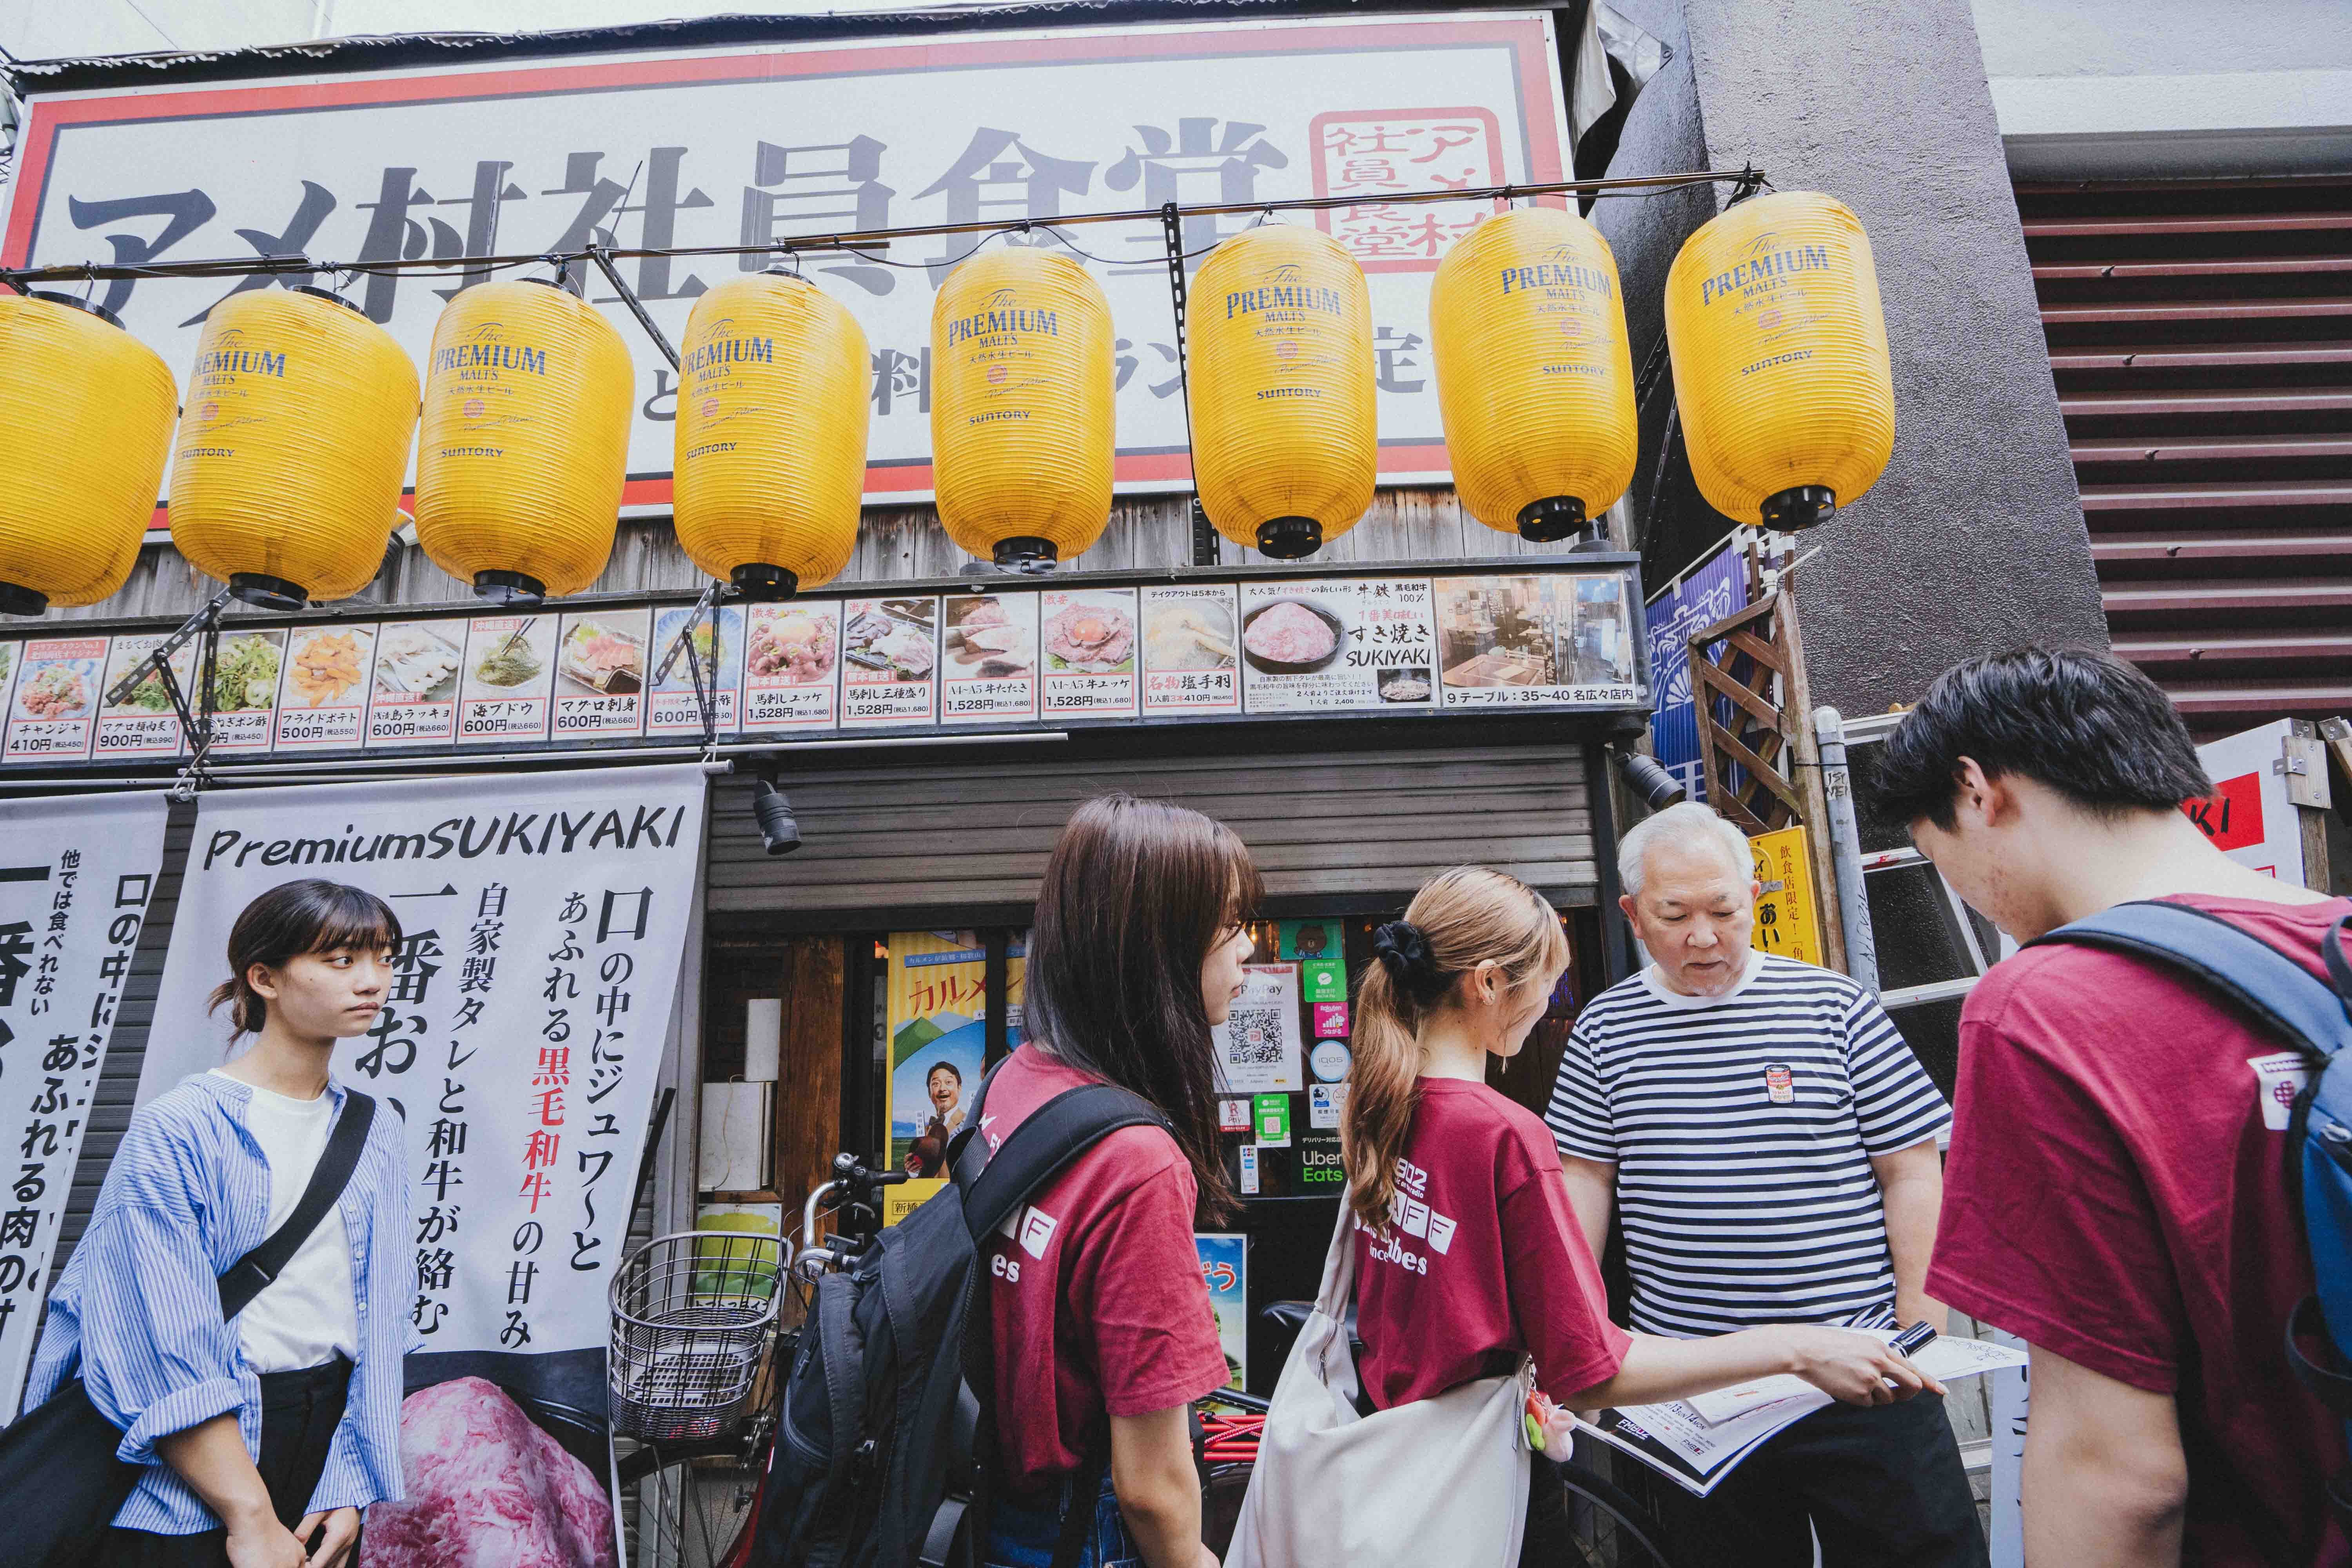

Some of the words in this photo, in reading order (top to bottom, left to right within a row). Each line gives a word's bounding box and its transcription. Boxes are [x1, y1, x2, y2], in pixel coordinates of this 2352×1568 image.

[1501, 264, 1613, 301] PREMIUM
[1701, 245, 1830, 307] PREMIUM
[1227, 286, 1341, 320] PREMIUM
[949, 309, 1058, 348] PREMIUM
[435, 344, 546, 376] PREMIUM
[681, 336, 773, 382] PREMIUM
[1741, 350, 1813, 376] SUNTORY
[1543, 364, 1606, 376] SUNTORY
[1257, 388, 1321, 400] SUNTORY
[969, 410, 1031, 426] SUNTORY
[182, 448, 235, 459] SUNTORY
[442, 447, 504, 458] SUNTORY
[686, 442, 738, 461] SUNTORY
[1044, 594, 1068, 606] 激安
[1151, 589, 1226, 598] テイクアウトは5本から
[1399, 593, 1425, 603] 100%
[1348, 623, 1430, 644] すき焼き
[1346, 647, 1430, 667] SUKIYAKI
[681, 694, 731, 707] ナ酢
[755, 693, 822, 705] 馬刺しユッケ
[848, 687, 926, 701] 馬刺し三種盛り
[561, 697, 637, 711] マグロ刺身
[947, 699, 994, 711] 1,528円
[1046, 695, 1093, 707] 1,528円
[473, 703, 534, 718] 海ブドウ
[654, 710, 697, 723] 600円
[748, 708, 793, 720] 1,528円
[846, 704, 892, 716] 1,528円
[282, 712, 358, 724] フライドポテト
[558, 715, 601, 728] 600円
[602, 717, 636, 725] (税込660)
[373, 723, 415, 736] 600円
[416, 724, 449, 732] (税込660)
[464, 719, 507, 732] 600円
[508, 721, 541, 730] (税込660)
[281, 726, 323, 739] 500円
[11, 738, 51, 751] 410円
[100, 734, 142, 747] 900円
[31, 849, 82, 1016] 他では食べれない
[411, 882, 509, 1335] 自家製タレと和牛が絡む
[500, 891, 588, 1349] あふれる黒毛和牛の甘み
[1302, 1151, 1343, 1165] Uber
[1303, 1167, 1343, 1182] Eats
